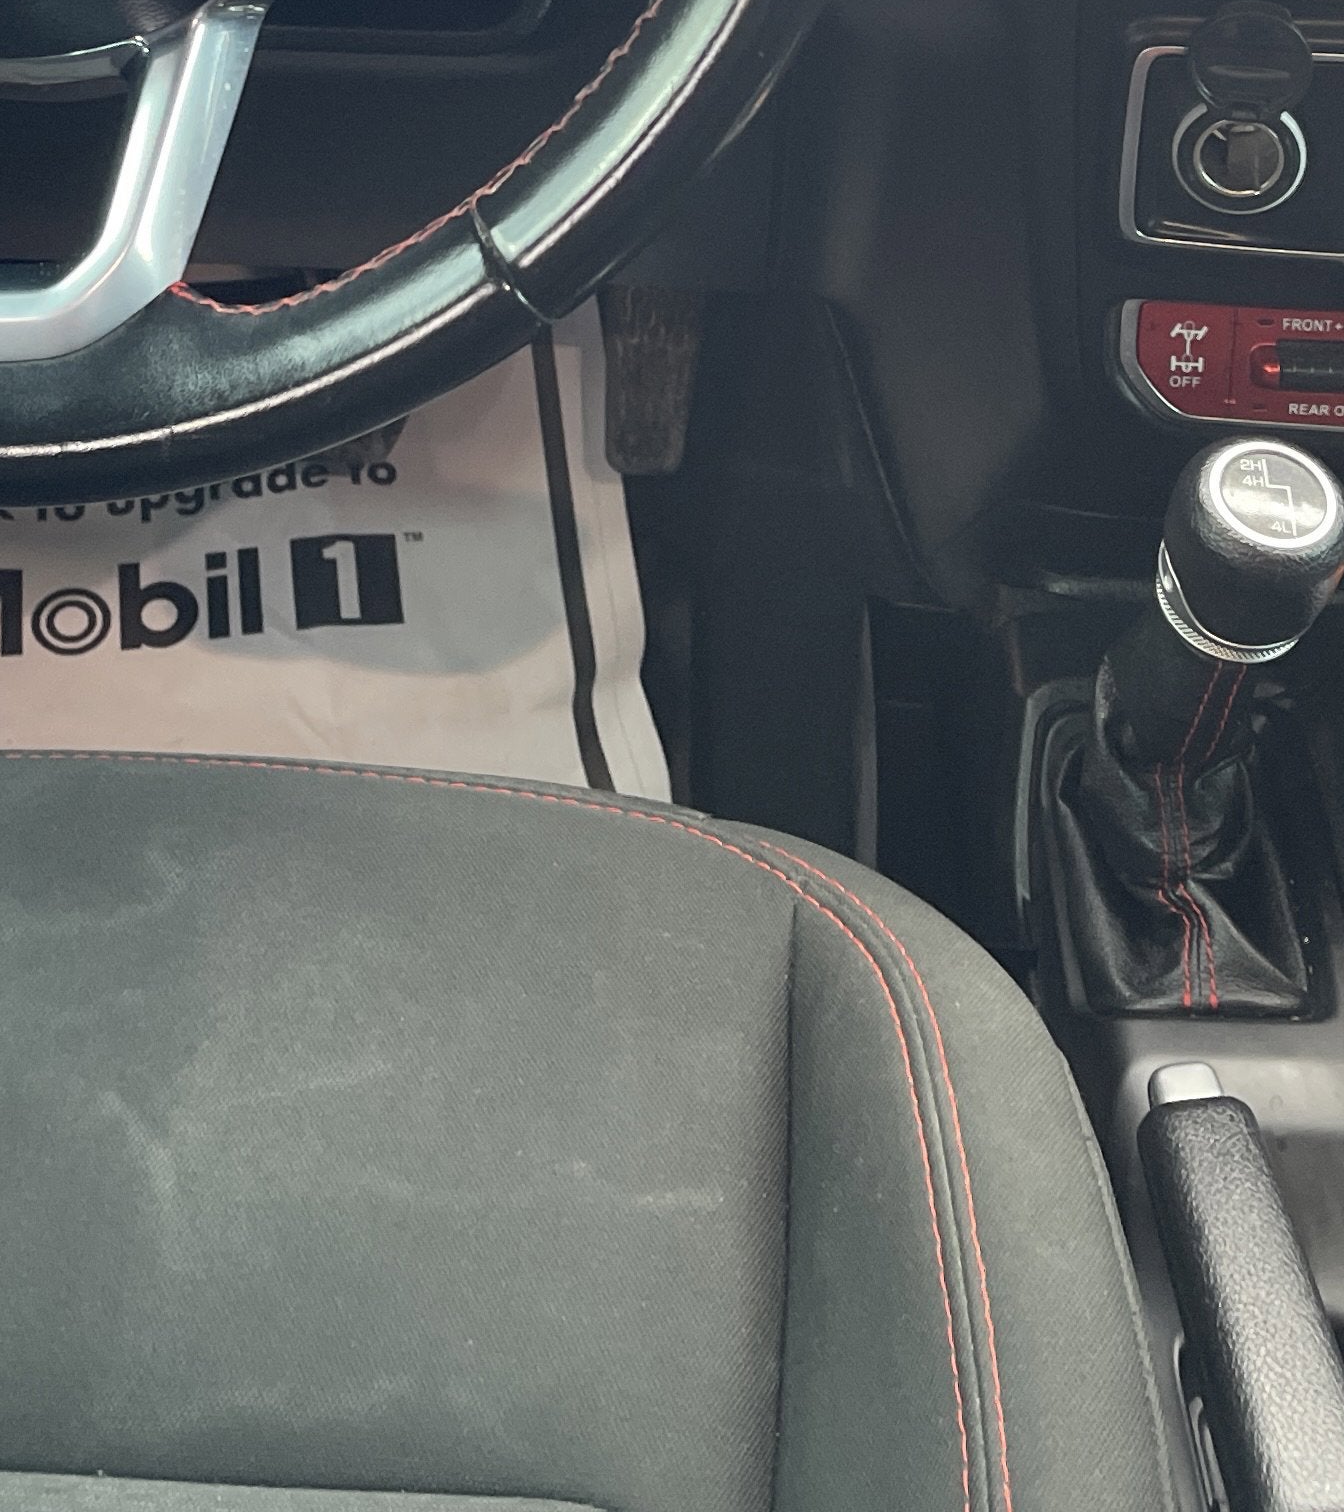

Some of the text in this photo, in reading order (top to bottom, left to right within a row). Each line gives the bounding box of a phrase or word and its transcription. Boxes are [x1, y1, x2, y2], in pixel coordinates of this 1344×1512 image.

[1282, 318, 1332, 333] FRONT
[1169, 375, 1201, 388] OFF
[1288, 403, 1329, 416] REAR
[1240, 458, 1262, 471] 2H
[1242, 475, 1265, 487] 4H
[1271, 521, 1292, 533] 4L
